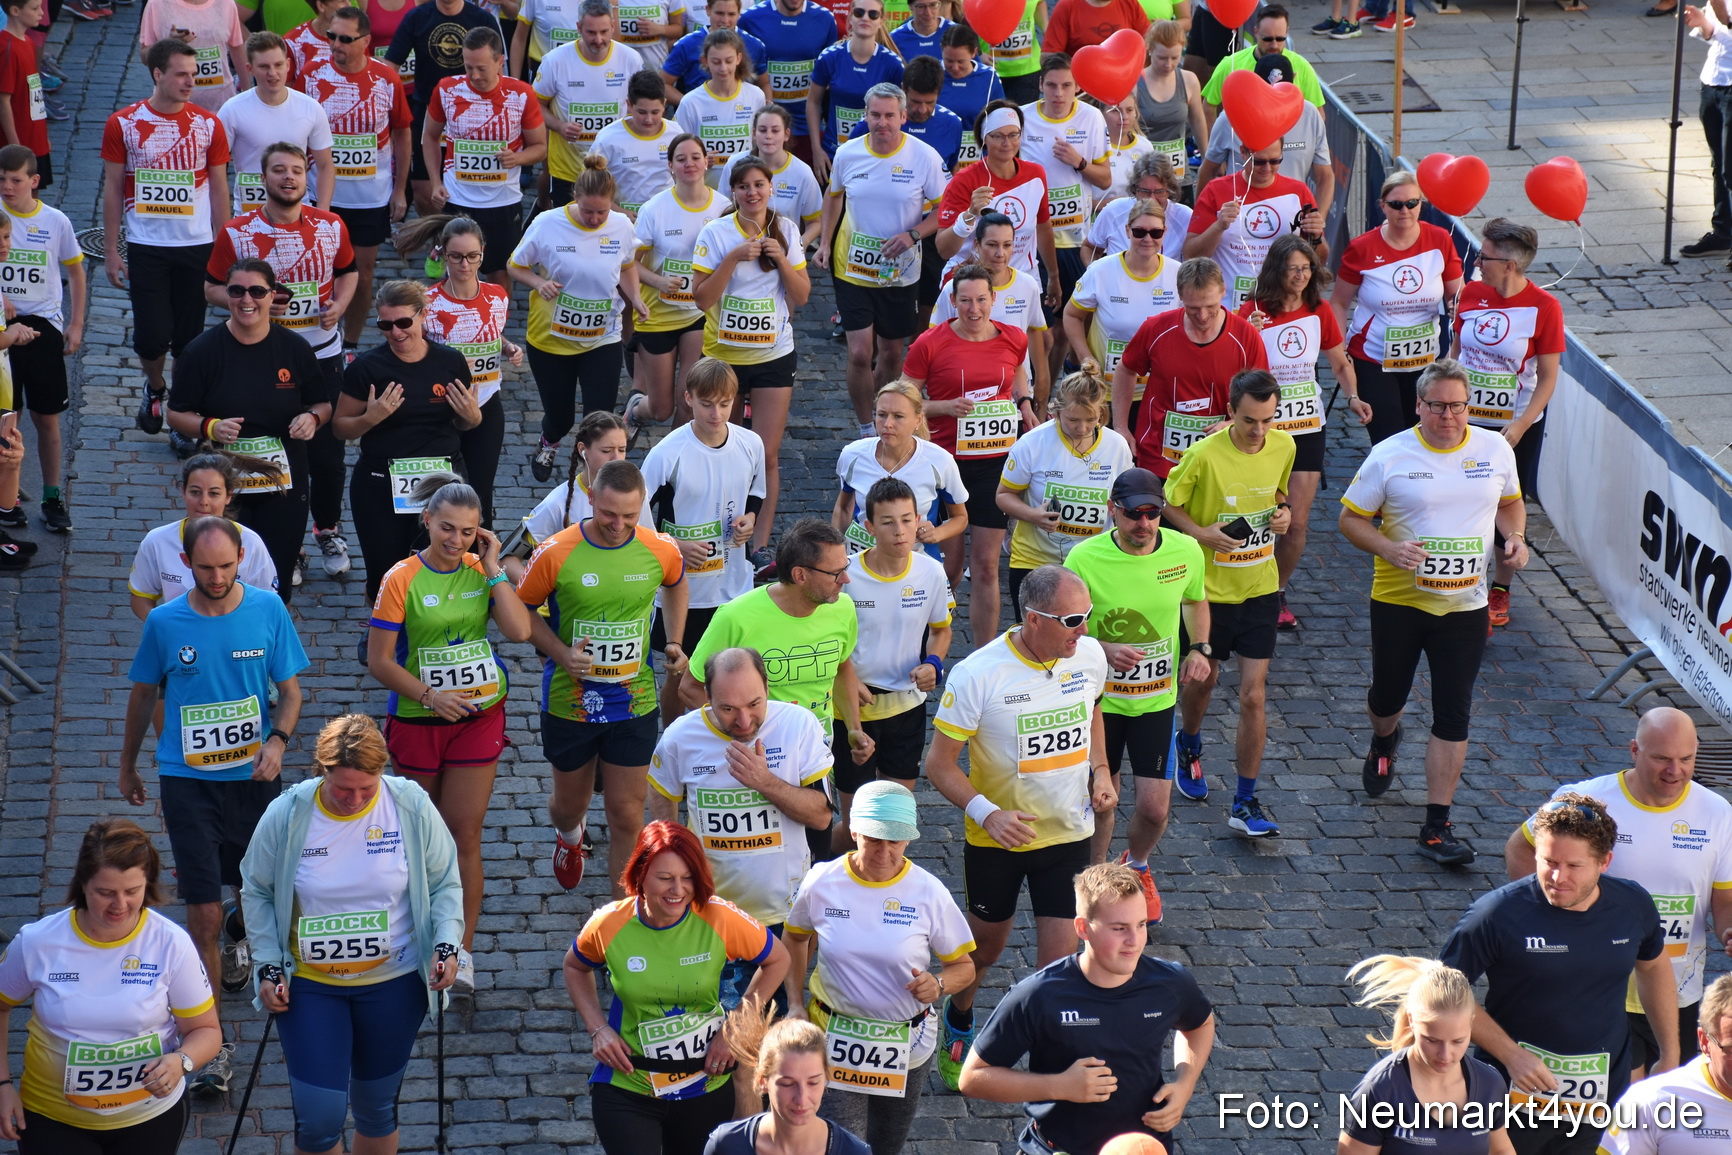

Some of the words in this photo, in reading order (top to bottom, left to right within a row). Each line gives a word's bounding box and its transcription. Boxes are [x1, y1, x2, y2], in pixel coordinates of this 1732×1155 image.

[619, 8, 656, 19] BOCK
[620, 20, 638, 34] 50
[999, 50, 1022, 58] MARIA
[771, 63, 811, 75] BOCK
[772, 75, 809, 90] 5245
[571, 104, 614, 115] BOCK
[703, 125, 746, 136] BOCK
[706, 140, 745, 154] 5037
[958, 146, 976, 159] 78
[331, 151, 372, 165] 5202
[459, 156, 501, 171] 5201
[138, 170, 192, 183] BOCK
[336, 168, 368, 176] STEFAN
[461, 172, 502, 182] MATTHIAS
[141, 187, 190, 203] 5200
[245, 187, 267, 202] 52
[145, 205, 184, 213] MANUEL
[1049, 200, 1078, 217] 029
[0, 265, 41, 284] 016
[2, 286, 27, 295] LEON
[288, 299, 312, 315] 97
[560, 293, 608, 311] BOCK
[727, 298, 772, 311] BOCK
[1381, 298, 1406, 308] LAUFEN
[1407, 298, 1419, 306] MIT
[558, 308, 604, 328] 5018
[725, 313, 771, 331] 5096
[558, 326, 599, 338] STEFANIE
[723, 332, 771, 343] ELISABETH
[1389, 323, 1434, 342] BOCK
[1390, 338, 1431, 358] 5121
[473, 356, 497, 374] 96
[1392, 357, 1429, 368] KERSTIN
[974, 390, 990, 400] DEHN
[1472, 389, 1510, 408] 120
[1273, 399, 1316, 420] 5125
[964, 418, 1012, 438] 5190
[1276, 419, 1314, 432] CLAUDIA
[230, 438, 278, 453] BOCK
[967, 439, 1008, 451] MELANIE
[395, 461, 446, 473] BOCK
[1462, 459, 1476, 470] 20
[1051, 484, 1106, 503] BOCK
[1060, 503, 1101, 524] 023
[1422, 538, 1480, 552] BOCK
[1229, 550, 1265, 563] PASCAL
[1423, 557, 1478, 576] 5231
[623, 573, 650, 583] BOCK
[1421, 577, 1476, 590] BERNHARD
[901, 587, 914, 598] 20
[901, 595, 929, 604] Neumarkter
[1638, 563, 1698, 635] stadtwerke
[901, 601, 923, 610] Stadtlauf
[579, 622, 640, 640] BOCK
[231, 648, 266, 660] BOCK
[426, 643, 486, 665] BOCK
[581, 640, 637, 664] 5152
[429, 662, 489, 689] 5151
[594, 666, 622, 678] EMIL
[1059, 671, 1072, 683] 20
[1112, 680, 1167, 694] MATTHIAS
[1004, 693, 1032, 703] BOCK
[189, 701, 254, 723] BOCK
[1023, 706, 1084, 731] BOCK
[191, 721, 256, 752] 5168
[1026, 726, 1083, 757] 5282
[202, 748, 249, 766] STEFAN
[692, 765, 718, 775] BOCK
[707, 808, 771, 834] 5011
[366, 827, 382, 841] 20
[1672, 821, 1690, 836] 20
[709, 836, 774, 851] MATTHIAS
[1671, 834, 1712, 845] Neumarkter
[366, 845, 398, 855] Stadtlauf
[1671, 842, 1704, 853] Stadtlauf
[884, 899, 900, 912] 20
[824, 908, 851, 919] BOCK
[882, 910, 920, 922] Neumarkter
[306, 914, 382, 936] BOCK
[882, 917, 913, 928] Stadtlauf
[309, 936, 382, 963] 5255
[122, 957, 141, 971] 20
[679, 951, 712, 966] BOCK
[48, 972, 81, 982] BOCK
[121, 969, 162, 980] Neumarkter
[120, 976, 154, 988] Stadtlauf
[834, 1014, 904, 1042] BOCK
[76, 1039, 157, 1066] BOCK
[831, 1039, 900, 1069] 5042
[832, 1069, 891, 1087] CLAUDIA
[1694, 1127, 1731, 1138] BOCK
